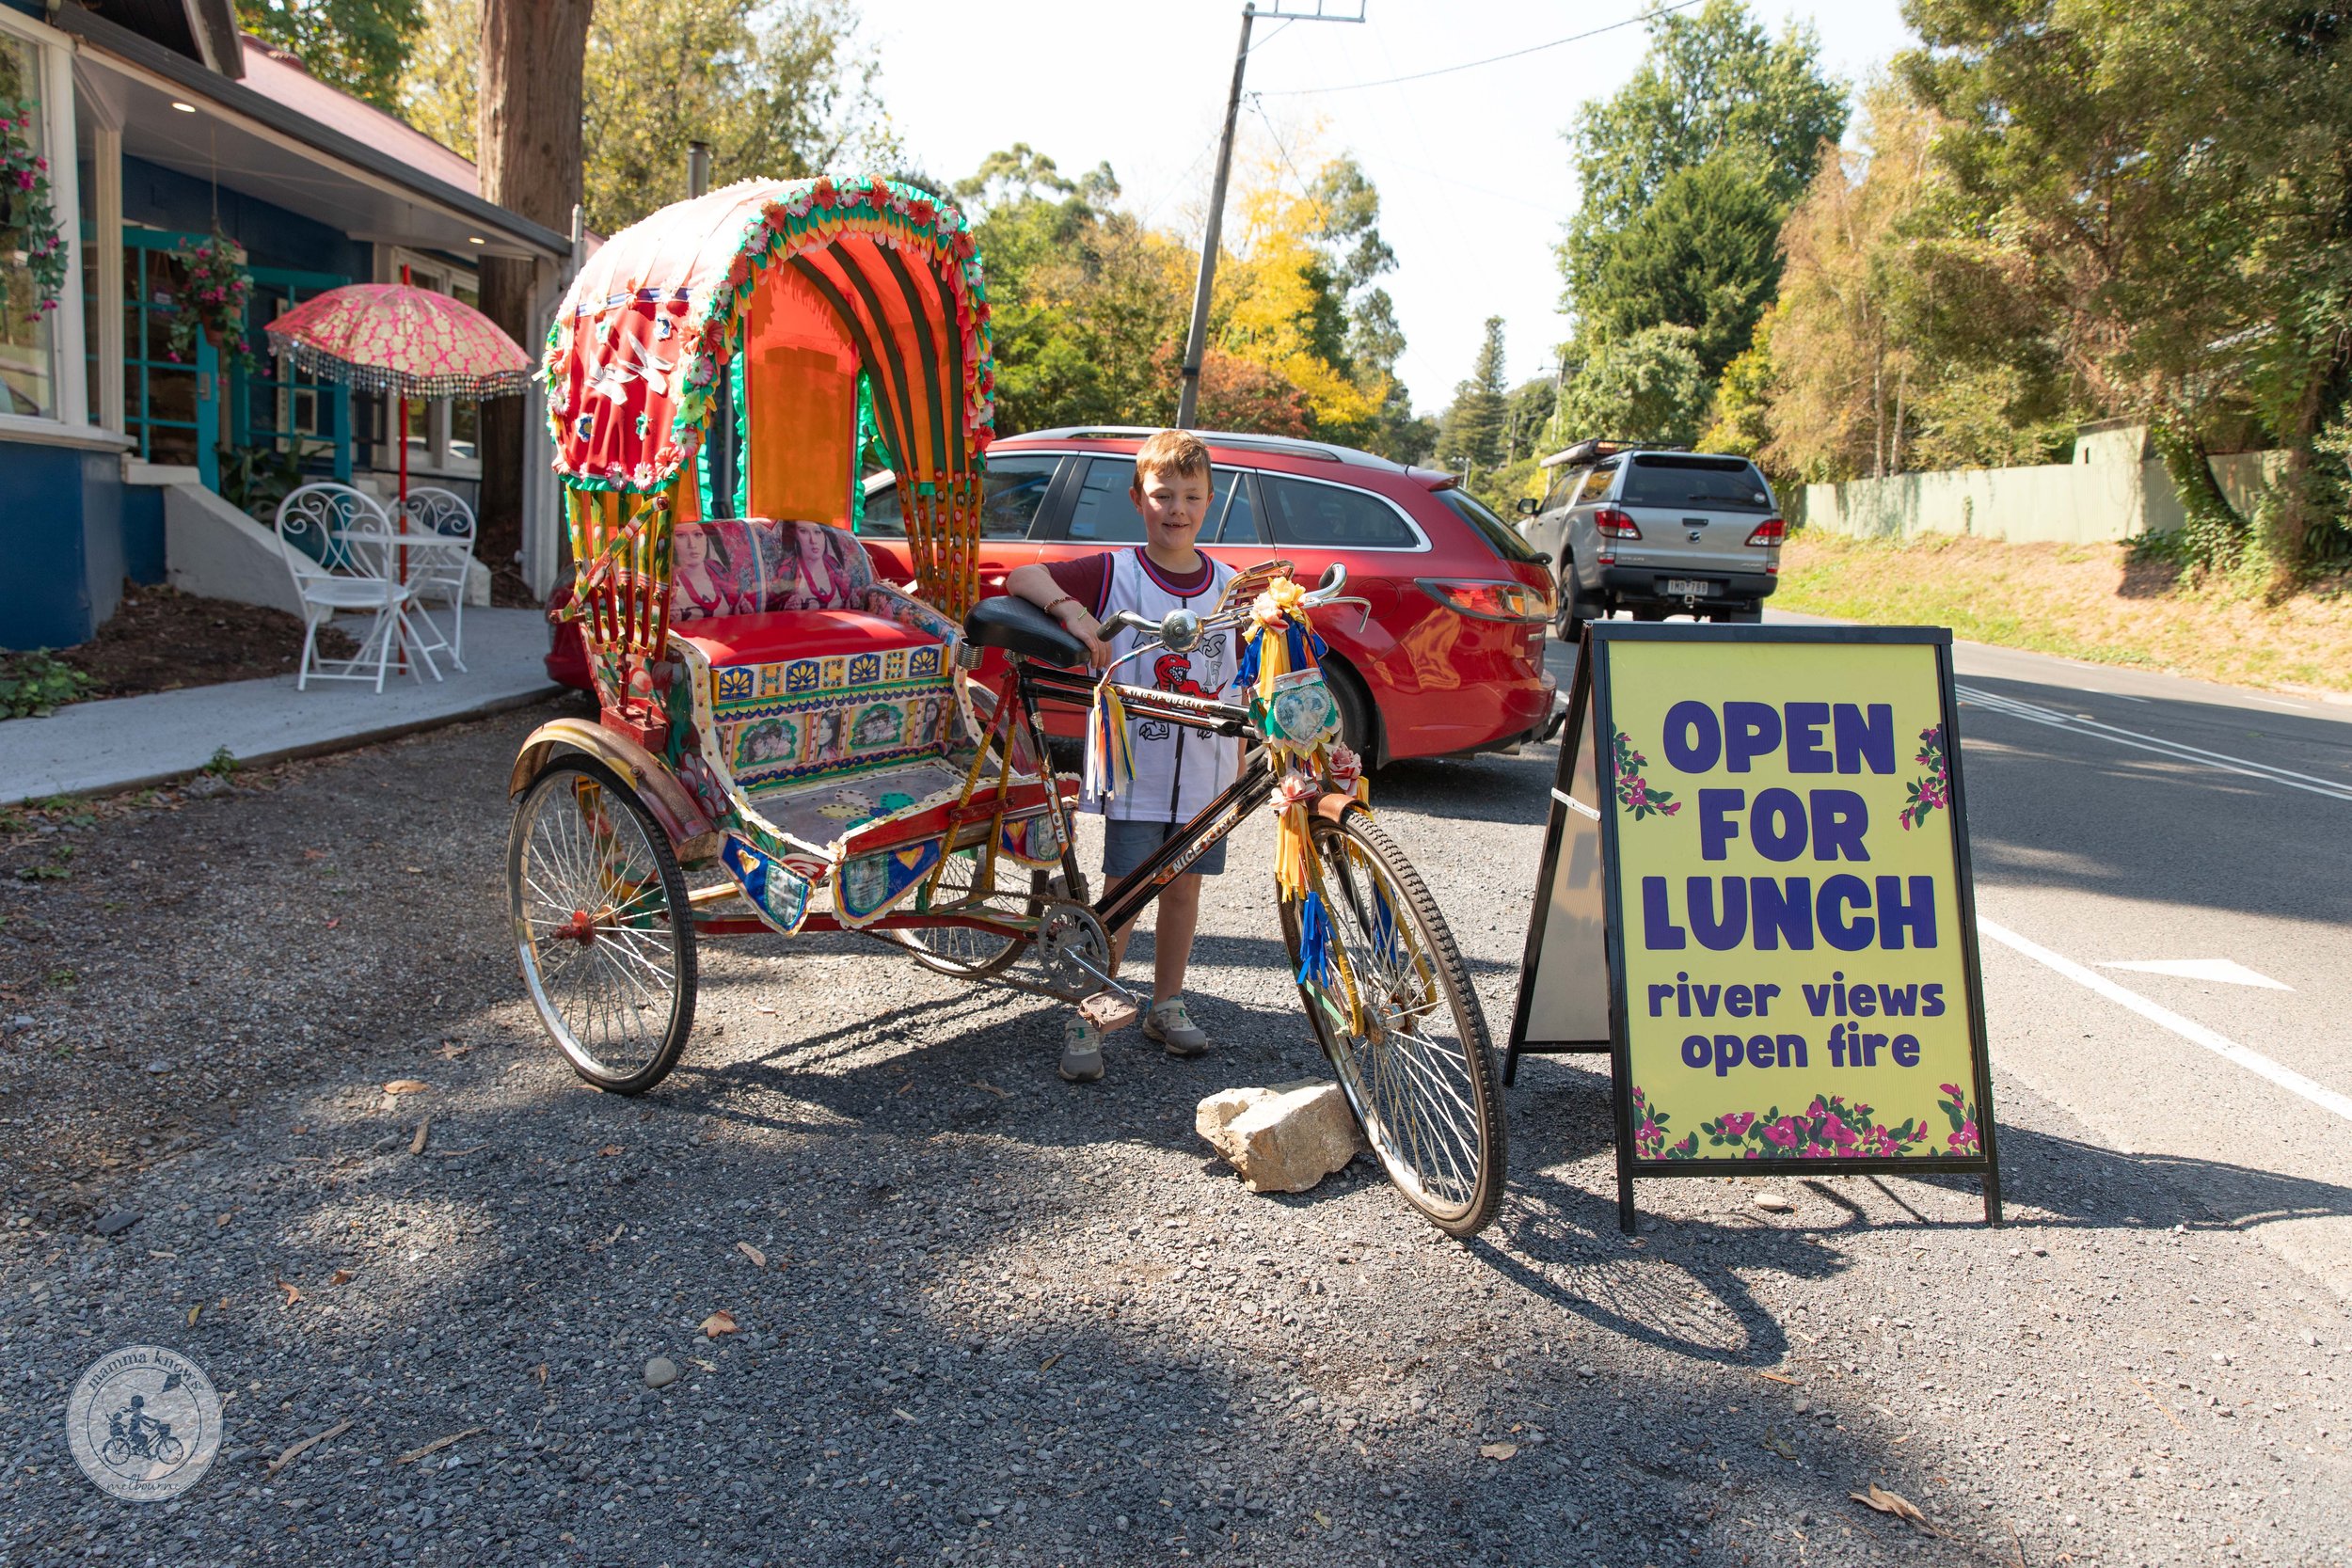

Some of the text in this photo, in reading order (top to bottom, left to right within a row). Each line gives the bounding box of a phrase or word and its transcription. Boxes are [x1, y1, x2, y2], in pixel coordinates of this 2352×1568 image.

[1203, 659, 1223, 687] 15
[1663, 700, 1896, 775] OPEN
[1172, 813, 1238, 874] NICE KING
[1698, 787, 1871, 862] FOR
[1642, 874, 1938, 952] LUNCH
[1648, 971, 1947, 1019] river views
[1681, 1021, 1921, 1078] open fire
